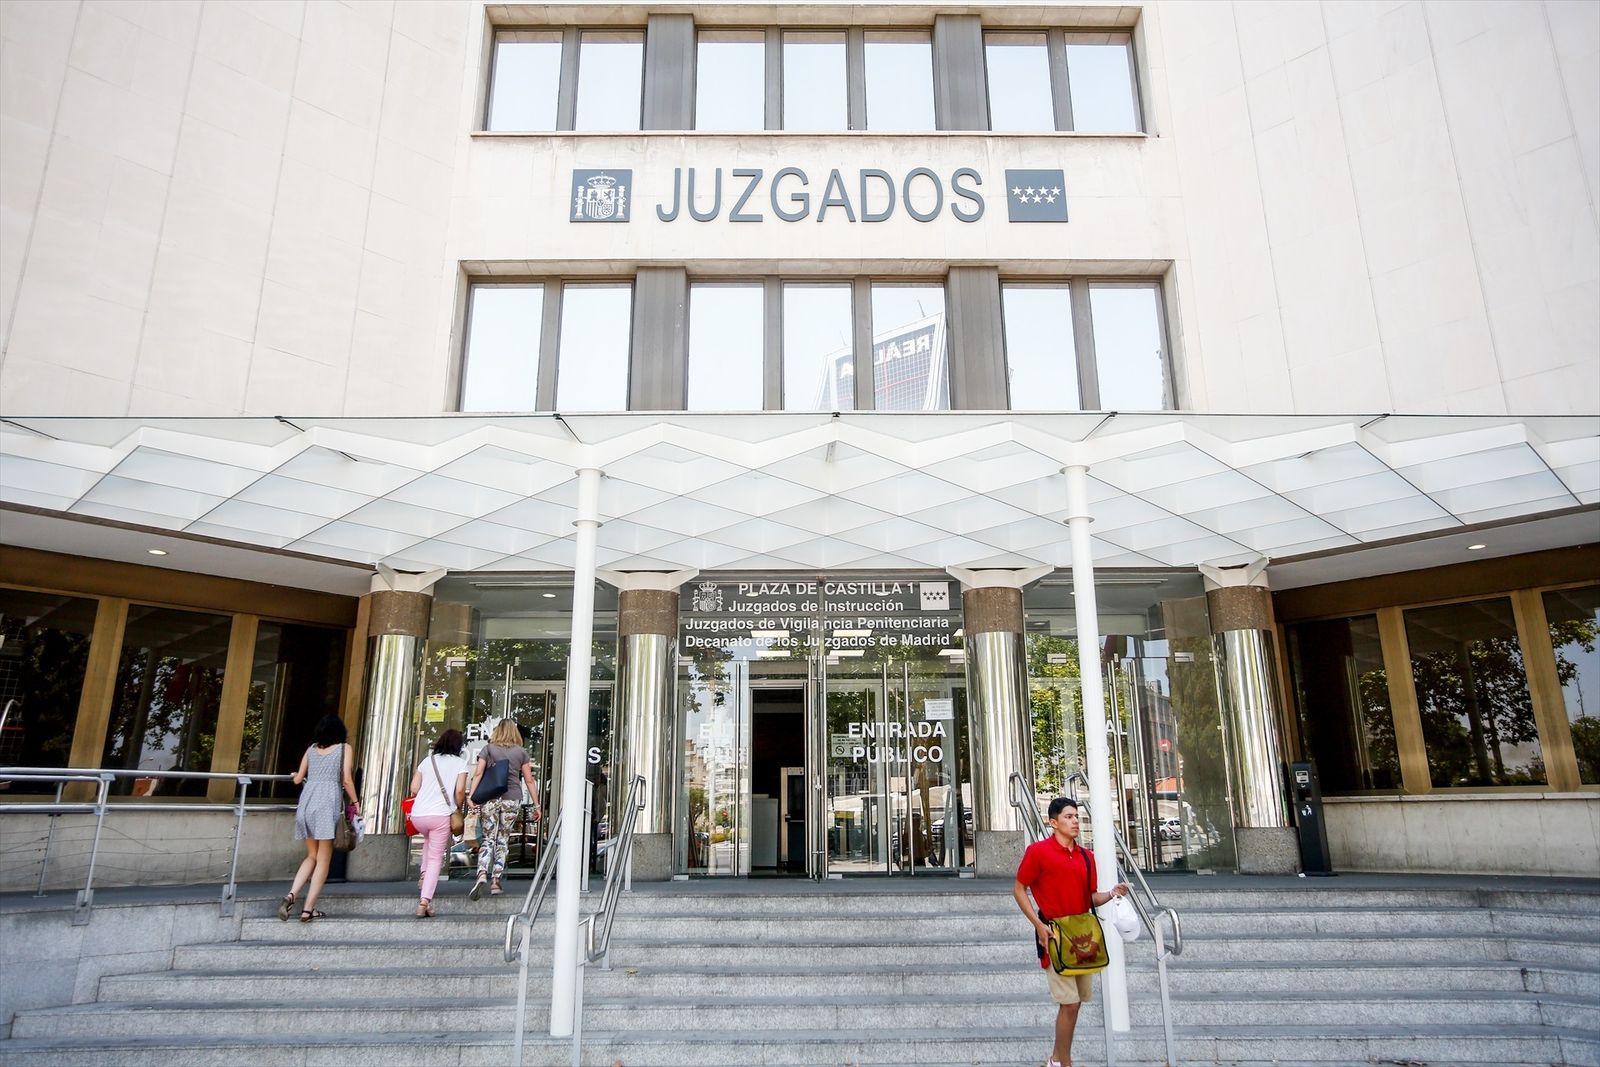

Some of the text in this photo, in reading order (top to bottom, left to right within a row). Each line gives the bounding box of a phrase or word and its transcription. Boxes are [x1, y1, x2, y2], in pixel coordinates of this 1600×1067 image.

[655, 166, 985, 223] JUZGADOS
[738, 582, 915, 596] PLAZA DE CASTILLA 1
[728, 599, 904, 615] Juzgados de Instrucción
[685, 616, 949, 633] Juzgados de Vigilancia Penitenciaria
[685, 633, 950, 650] Decanato de los Juzgados de Madrid
[848, 721, 947, 738] ENTRADA
[853, 742, 944, 763] PÚBLICO
